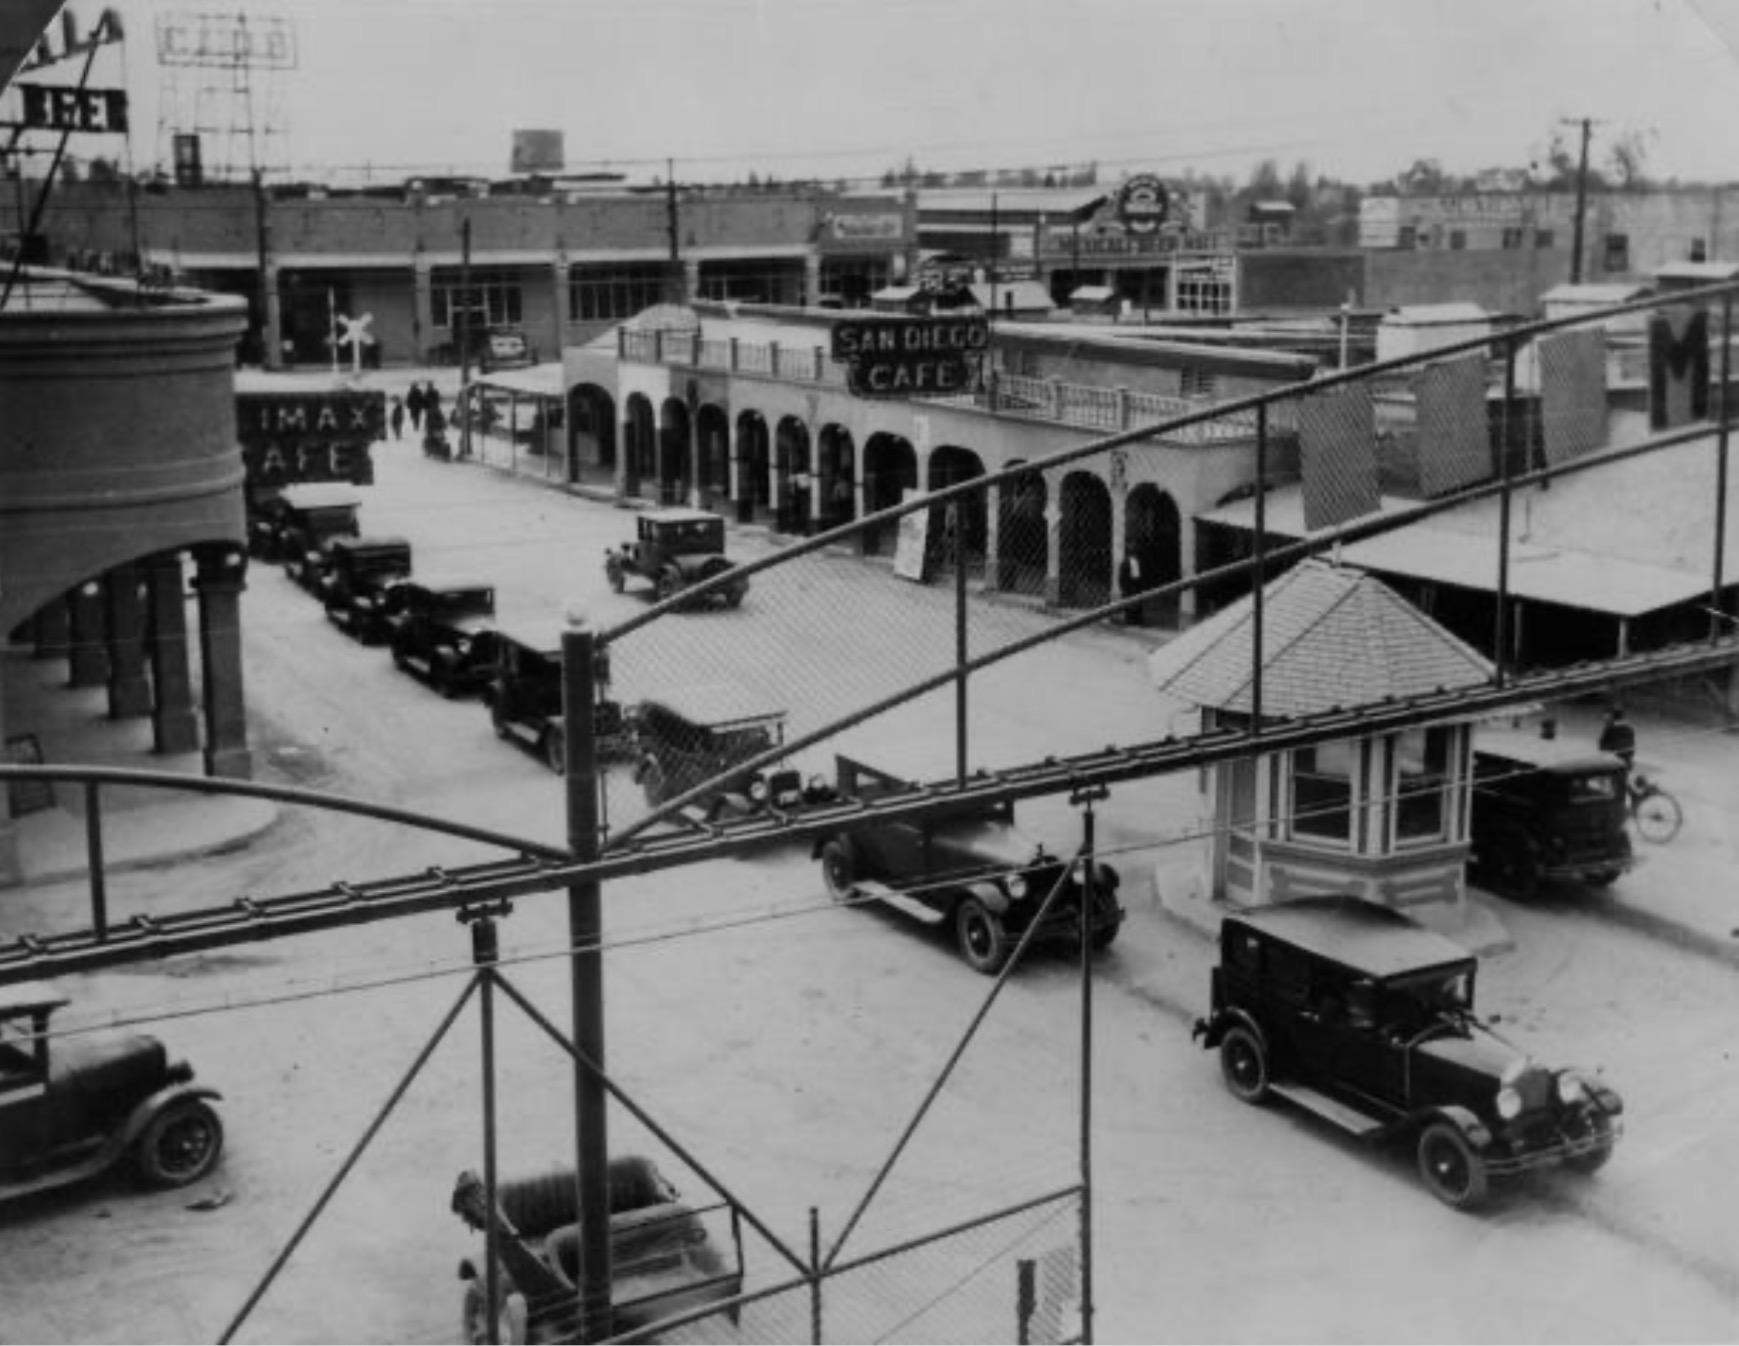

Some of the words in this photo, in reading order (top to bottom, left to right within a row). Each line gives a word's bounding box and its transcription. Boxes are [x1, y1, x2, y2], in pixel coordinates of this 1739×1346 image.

[839, 326, 896, 352] SAN
[904, 324, 986, 350] DIEGO
[868, 360, 960, 389] CAFE
